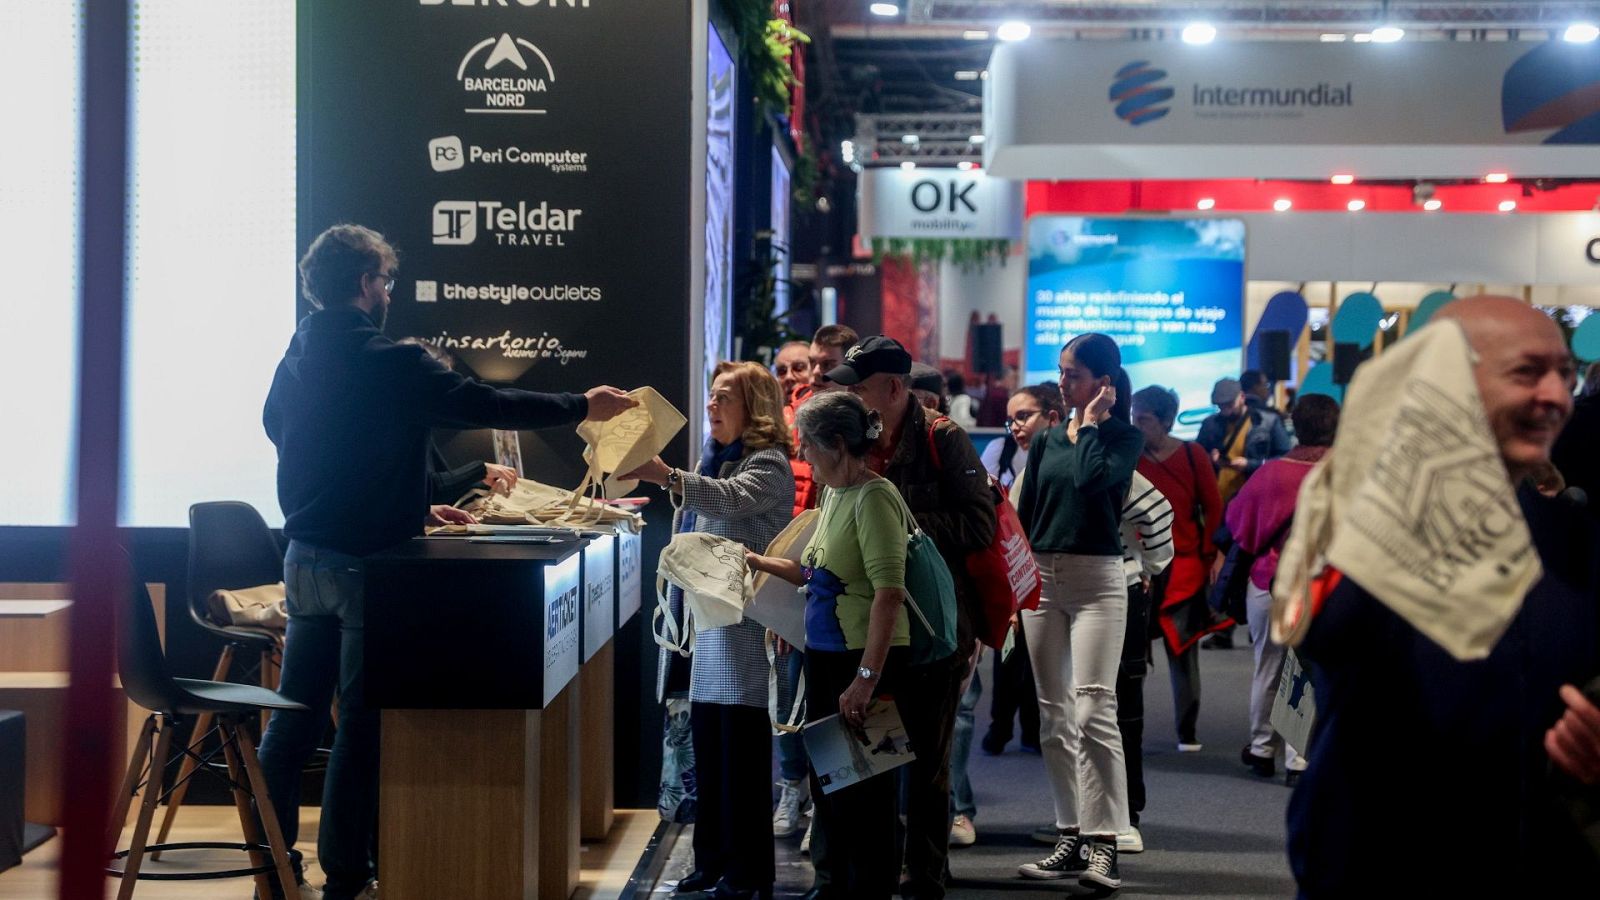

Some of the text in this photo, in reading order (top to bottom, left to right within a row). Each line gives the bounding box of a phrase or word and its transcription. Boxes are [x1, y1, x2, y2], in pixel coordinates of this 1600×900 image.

[464, 78, 547, 91] BARCELONA
[1193, 83, 1353, 106] Intermundial
[486, 93, 525, 106] NORD
[469, 146, 588, 166] Peri Computer
[551, 164, 588, 173] systems
[911, 181, 976, 212] OK
[478, 200, 582, 231] Teldar
[495, 233, 565, 246] TRAVEL
[443, 283, 602, 305] thestyleoutlets
